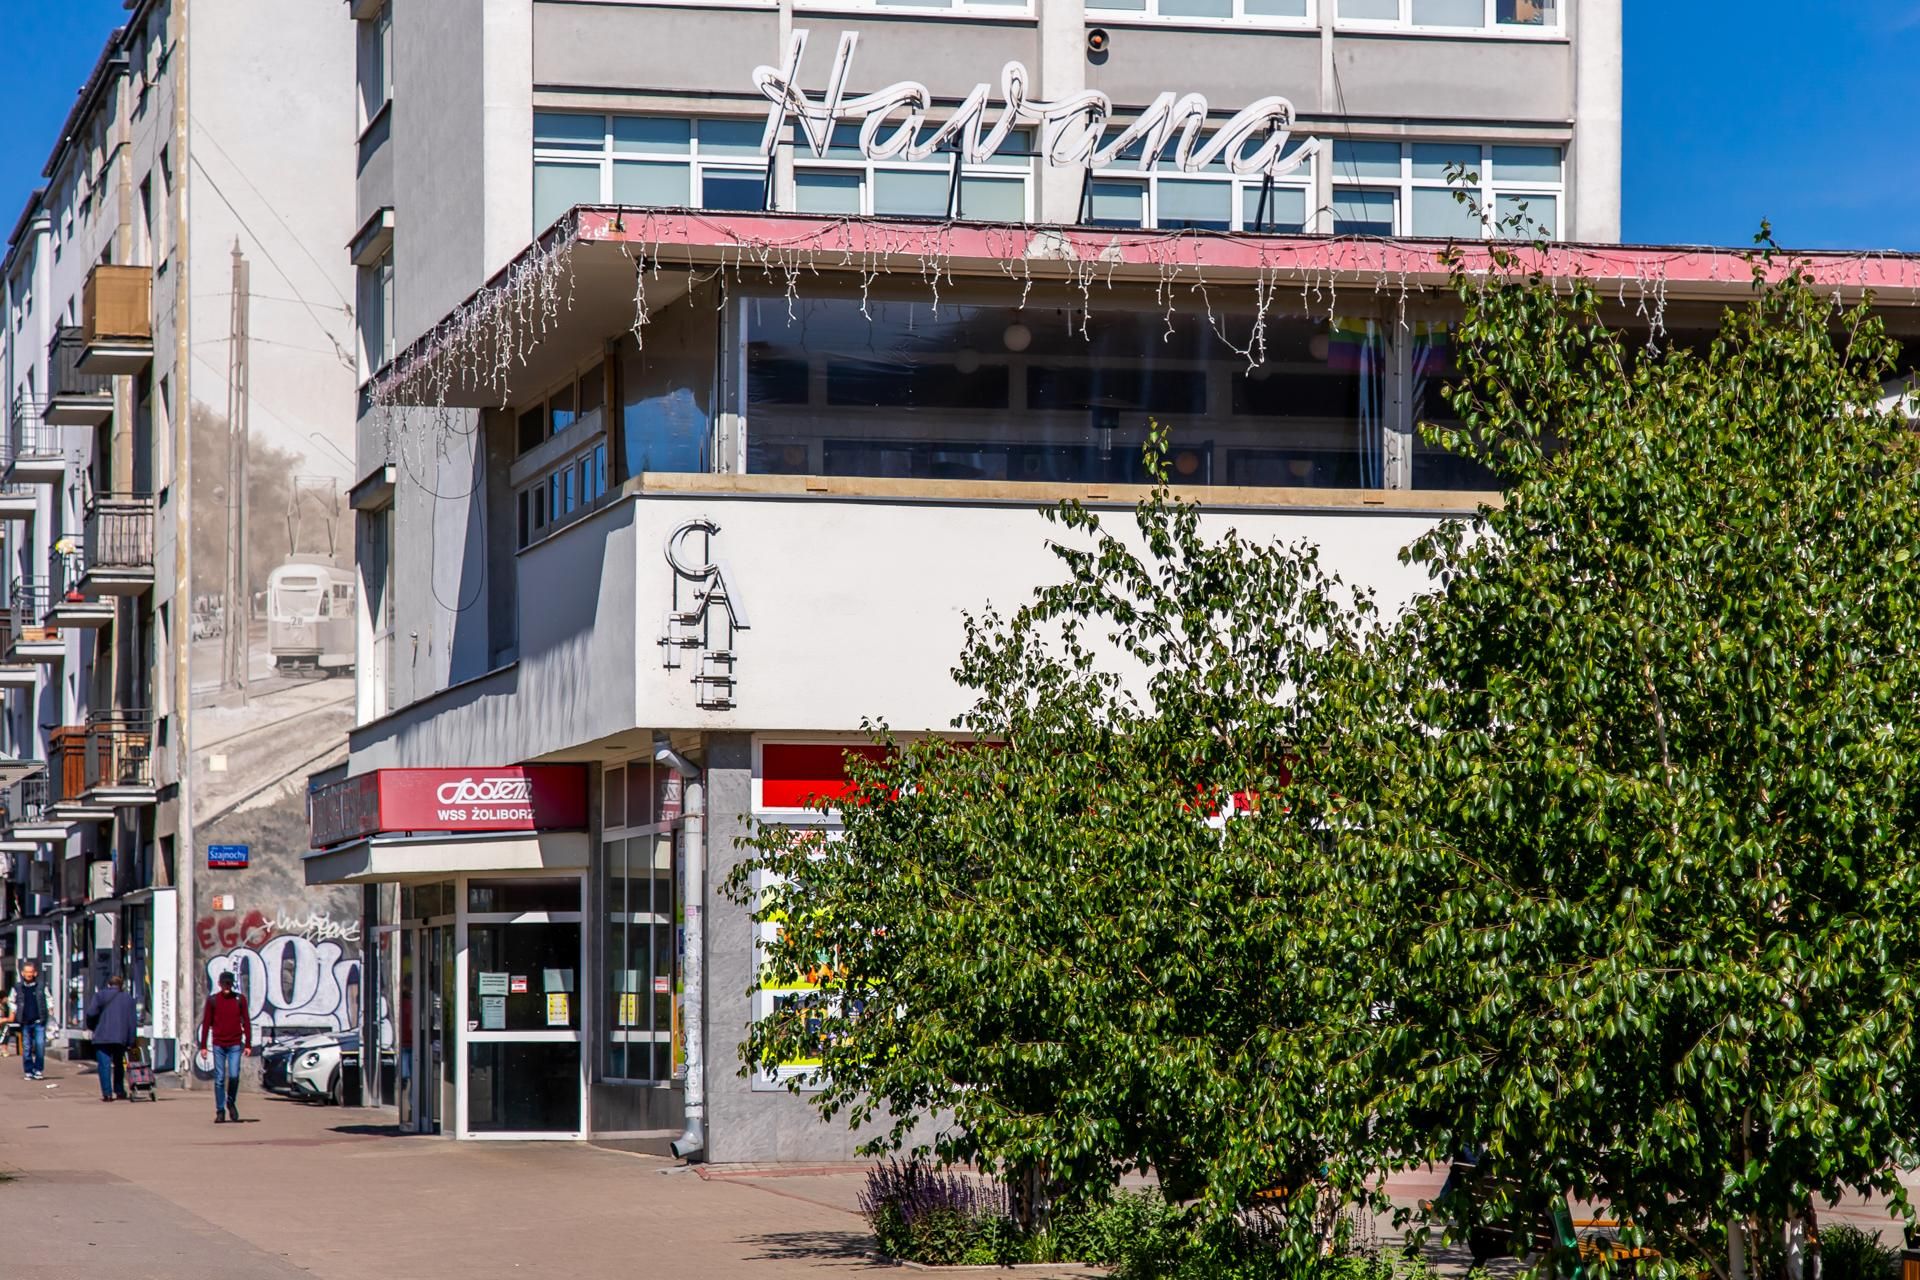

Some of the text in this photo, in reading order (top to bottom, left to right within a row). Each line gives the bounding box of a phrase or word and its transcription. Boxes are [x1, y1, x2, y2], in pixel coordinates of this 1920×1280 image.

[752, 30, 1321, 174] Havana
[437, 806, 535, 821] WSS ŻOLIBORZ
